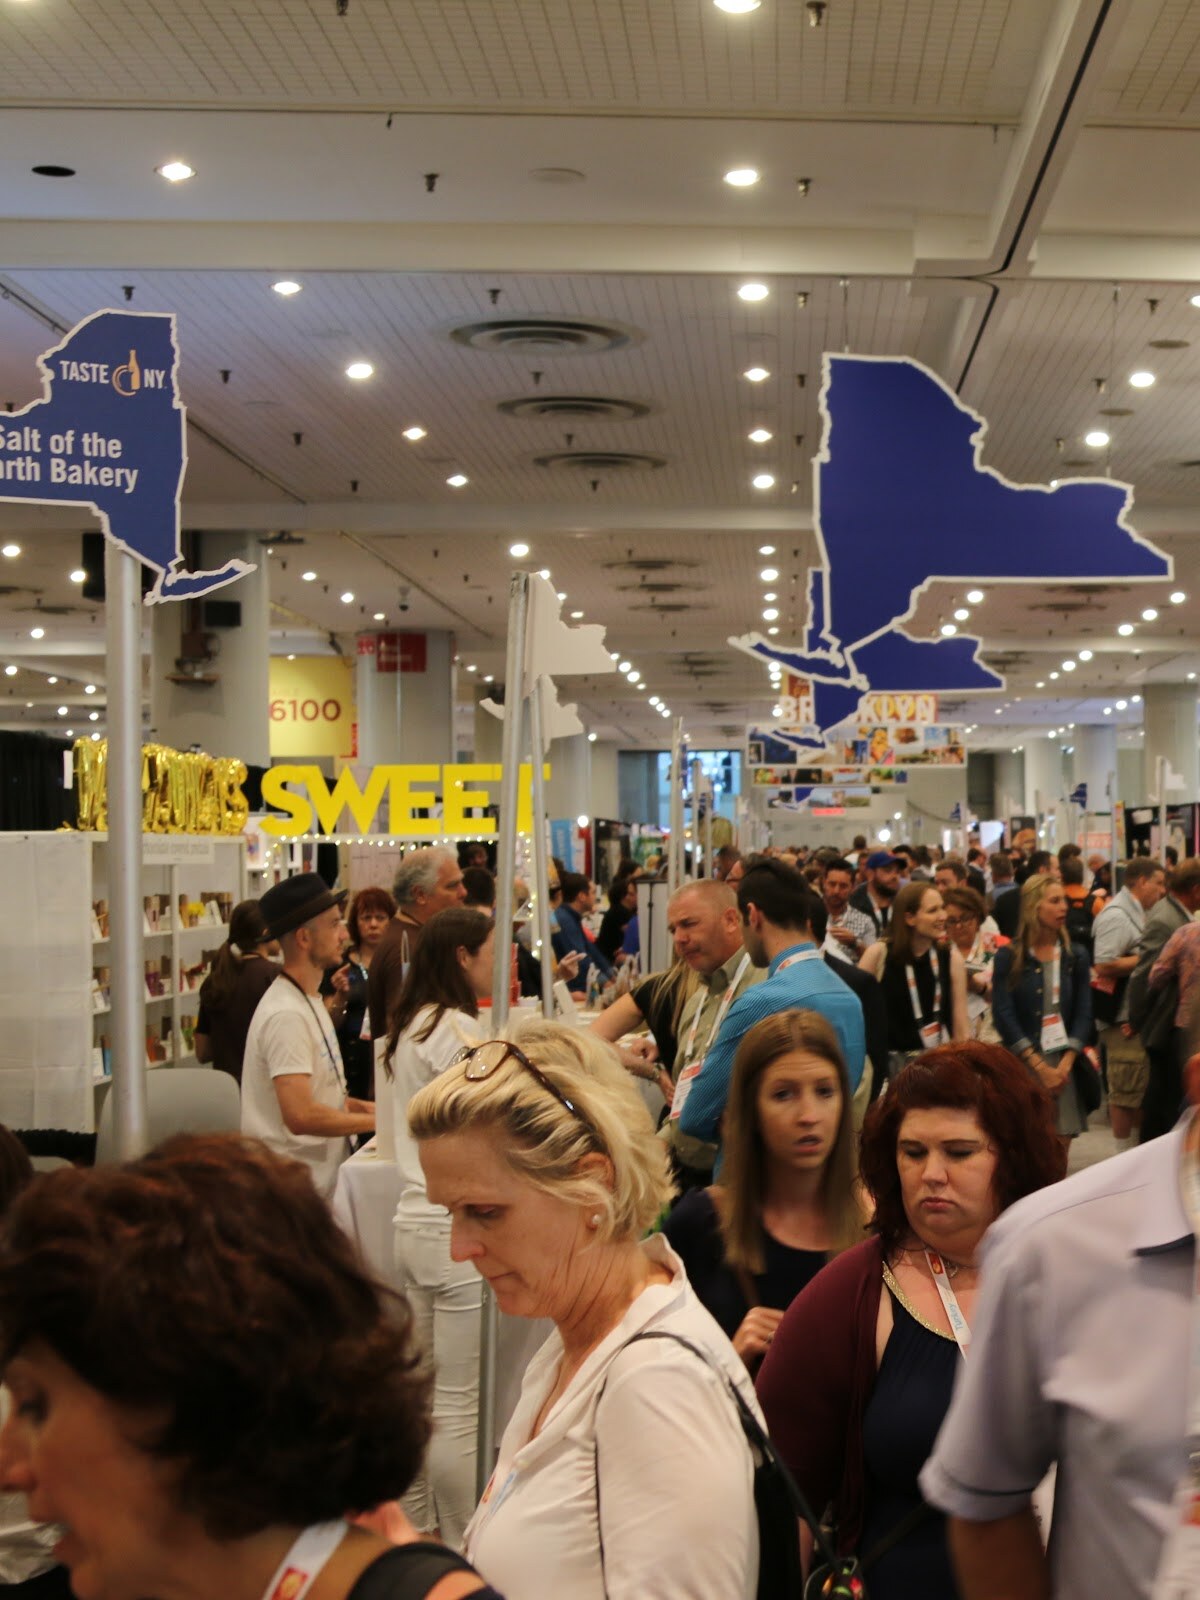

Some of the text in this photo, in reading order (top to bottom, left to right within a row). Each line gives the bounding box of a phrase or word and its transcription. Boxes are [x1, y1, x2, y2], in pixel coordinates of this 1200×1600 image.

[59, 360, 166, 389] TASTE NY
[50, 430, 75, 455] of
[81, 432, 122, 459] the
[0, 456, 139, 494] rth Bakery
[268, 699, 341, 722] 6100
[779, 695, 935, 724] BRKLYN
[258, 763, 551, 836] SWEET
[948, 1302, 964, 1331] Turkey
